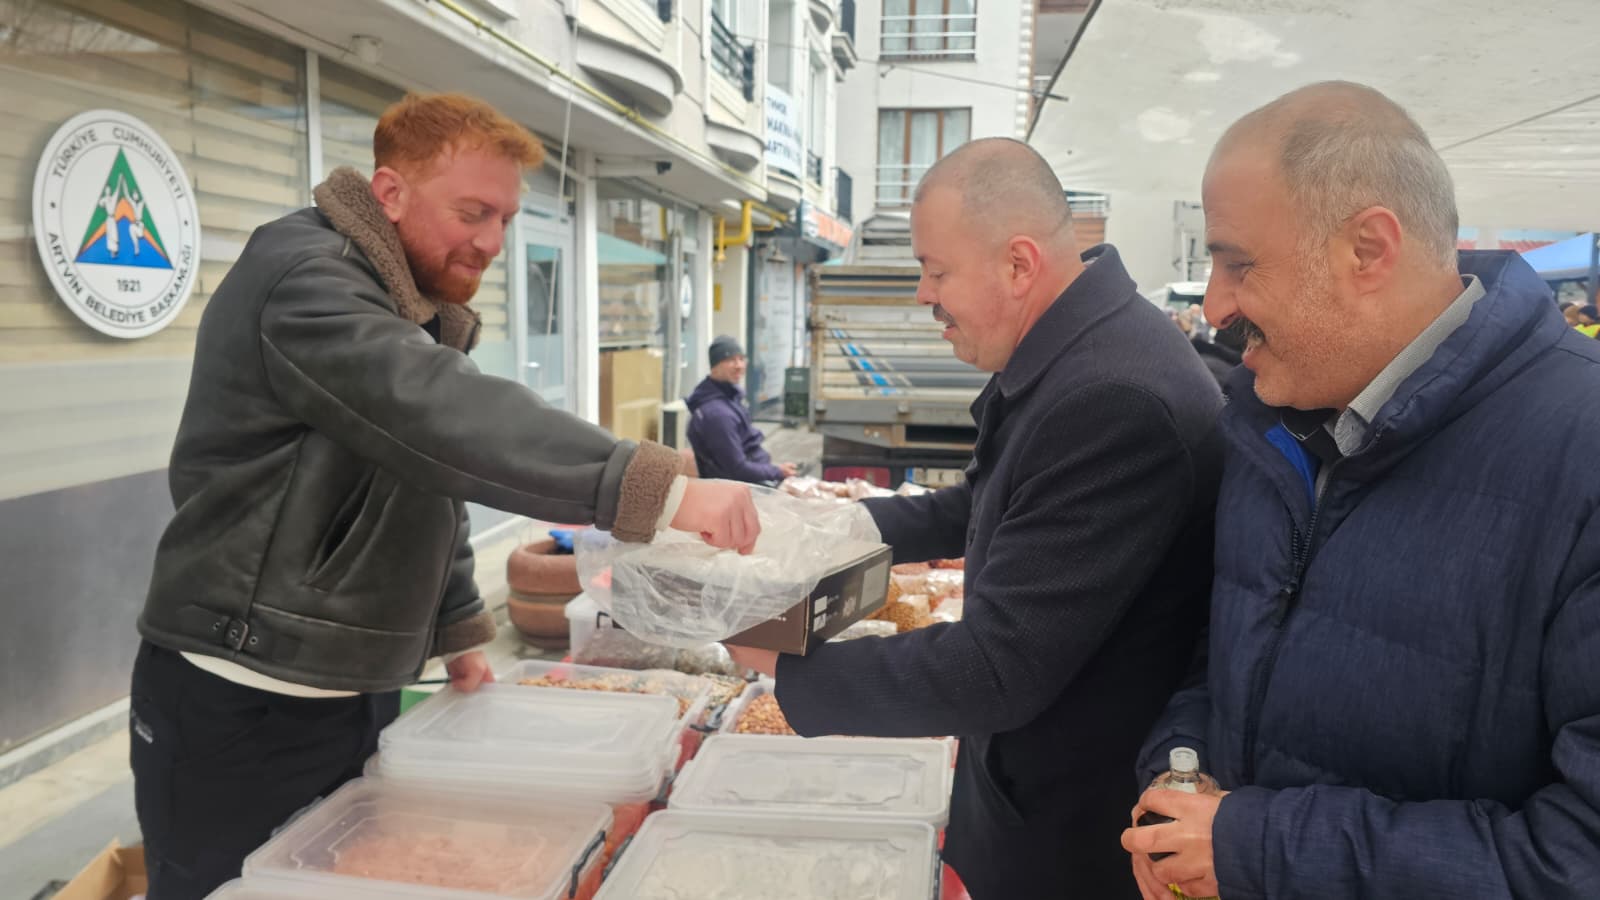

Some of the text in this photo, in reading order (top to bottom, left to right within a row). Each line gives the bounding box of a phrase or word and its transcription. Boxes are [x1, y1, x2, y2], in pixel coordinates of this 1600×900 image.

[53, 127, 185, 200] TÜRKİYE CUMHURİYETİ
[48, 232, 193, 324] ARTVİN BELEDİYE BAŞKANLIĞI
[117, 279, 141, 292] 1921
